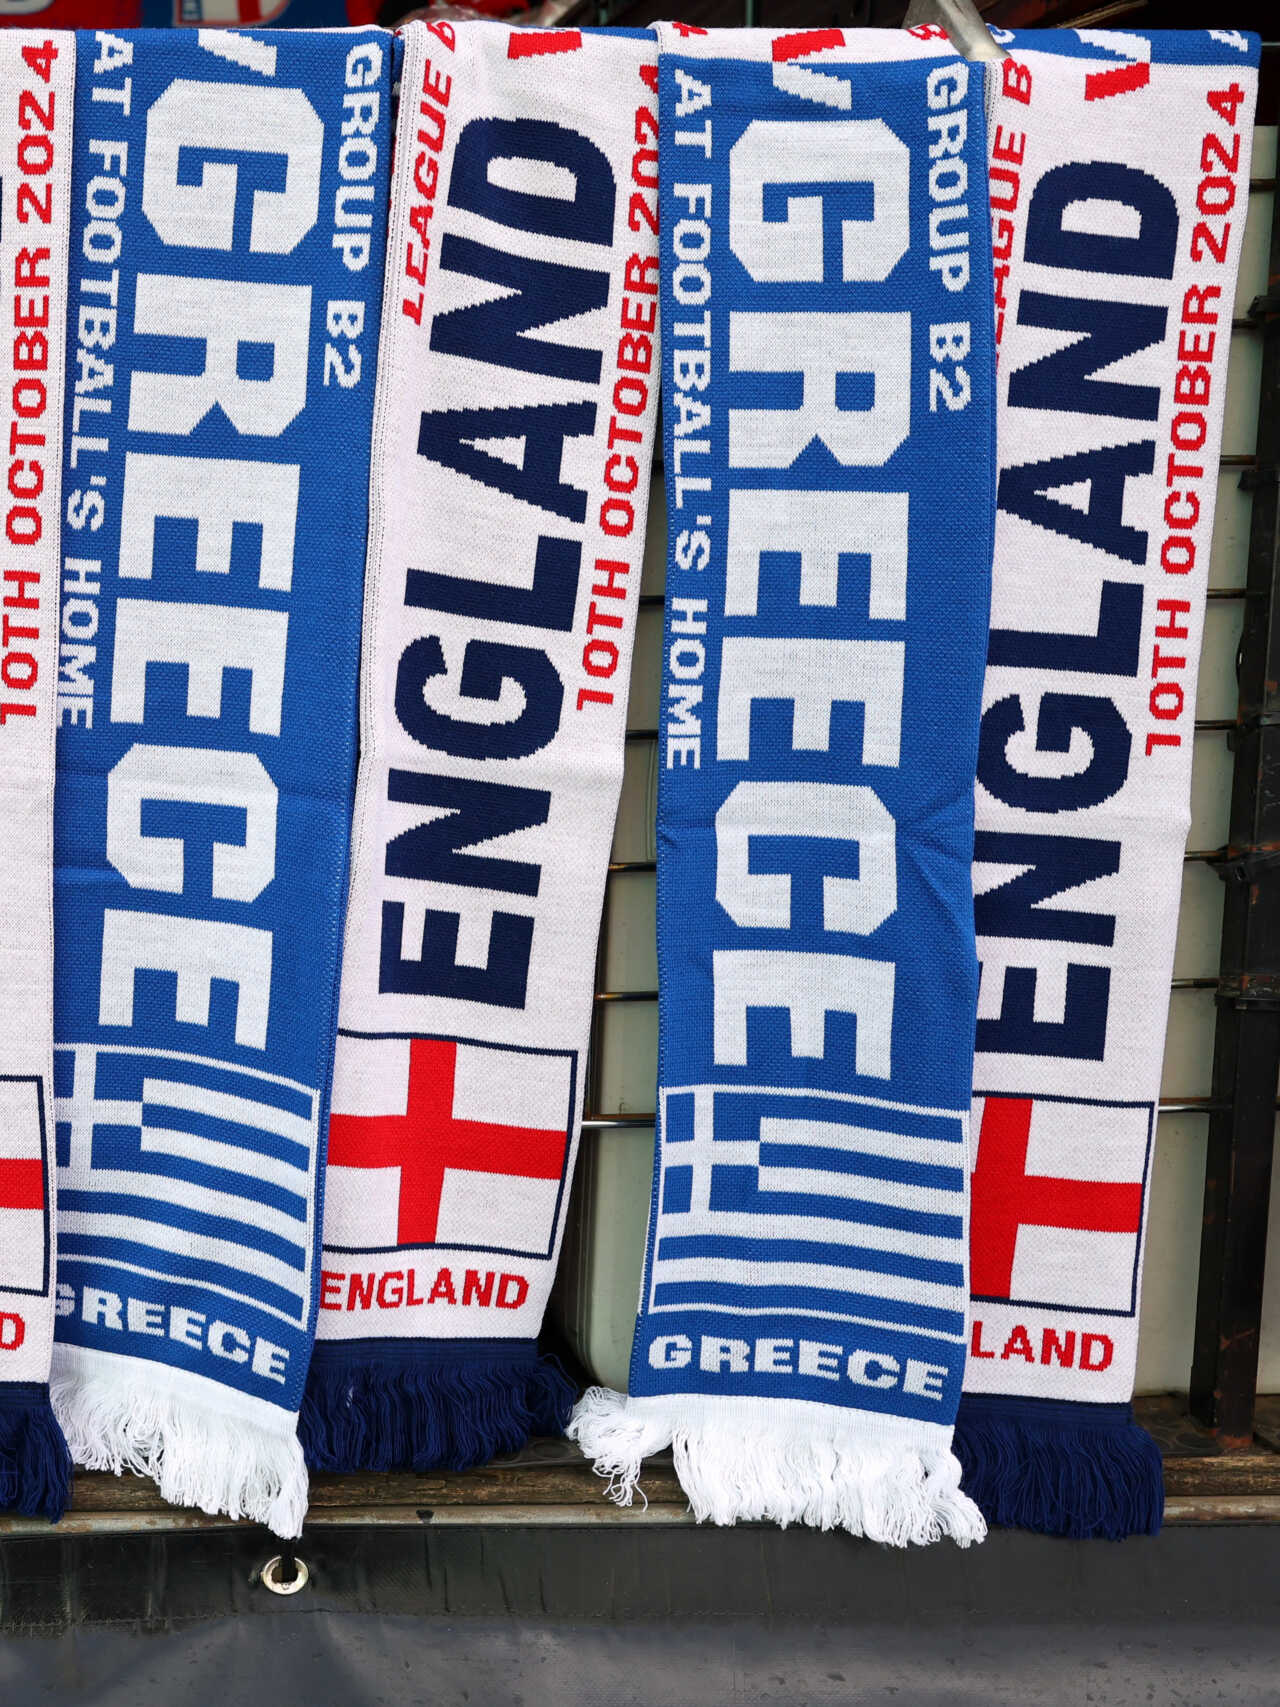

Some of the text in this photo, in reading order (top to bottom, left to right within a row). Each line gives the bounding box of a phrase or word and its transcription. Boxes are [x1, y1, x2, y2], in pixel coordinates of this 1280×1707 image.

[325, 43, 384, 389] GROUP B2
[404, 61, 452, 326] LEAGUE
[676, 70, 713, 159] AT
[1003, 59, 1033, 105] B
[1192, 85, 1245, 264] 2024
[674, 184, 713, 571] FOOTBALL'S
[928, 63, 972, 412] GROUP B2
[1, 42, 59, 725] 10TH OCTOBER 2024
[56, 32, 134, 729] AT FOOTBALL'S HOME
[599, 255, 659, 538] OCTOBER
[1158, 286, 1222, 575] OCTOBER
[97, 79, 325, 1051] GREECE
[380, 118, 617, 1010] ENGLAND
[578, 561, 630, 711] 10TH
[668, 599, 708, 769] HOME
[714, 119, 912, 1080] GREECE
[974, 162, 1180, 1062] ENGLAND
[1147, 601, 1191, 756] 10TH
[321, 1269, 529, 1311] ENGLAND
[650, 1336, 949, 1401] GREECE
[972, 1322, 1114, 1372] LAND
